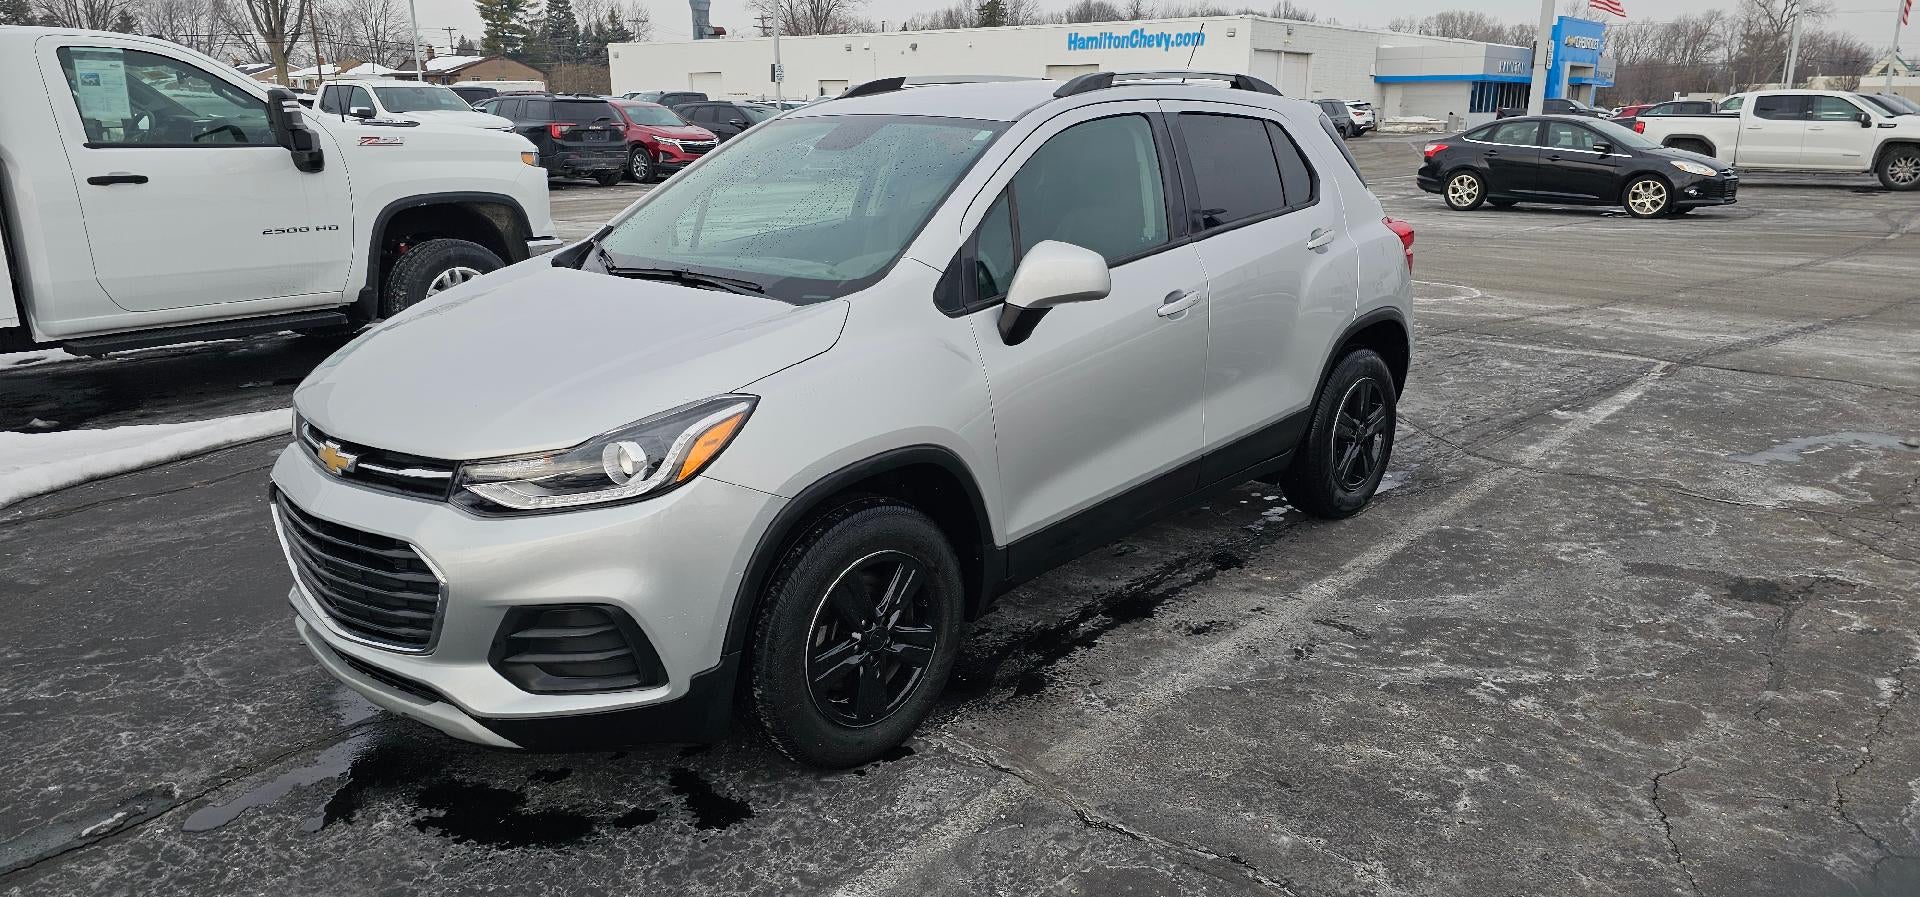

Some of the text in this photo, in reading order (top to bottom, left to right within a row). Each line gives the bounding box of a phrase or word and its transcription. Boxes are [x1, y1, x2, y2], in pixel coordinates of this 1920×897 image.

[1068, 28, 1205, 52] HamiltonChevy.com
[262, 224, 339, 235] 2500 HD
